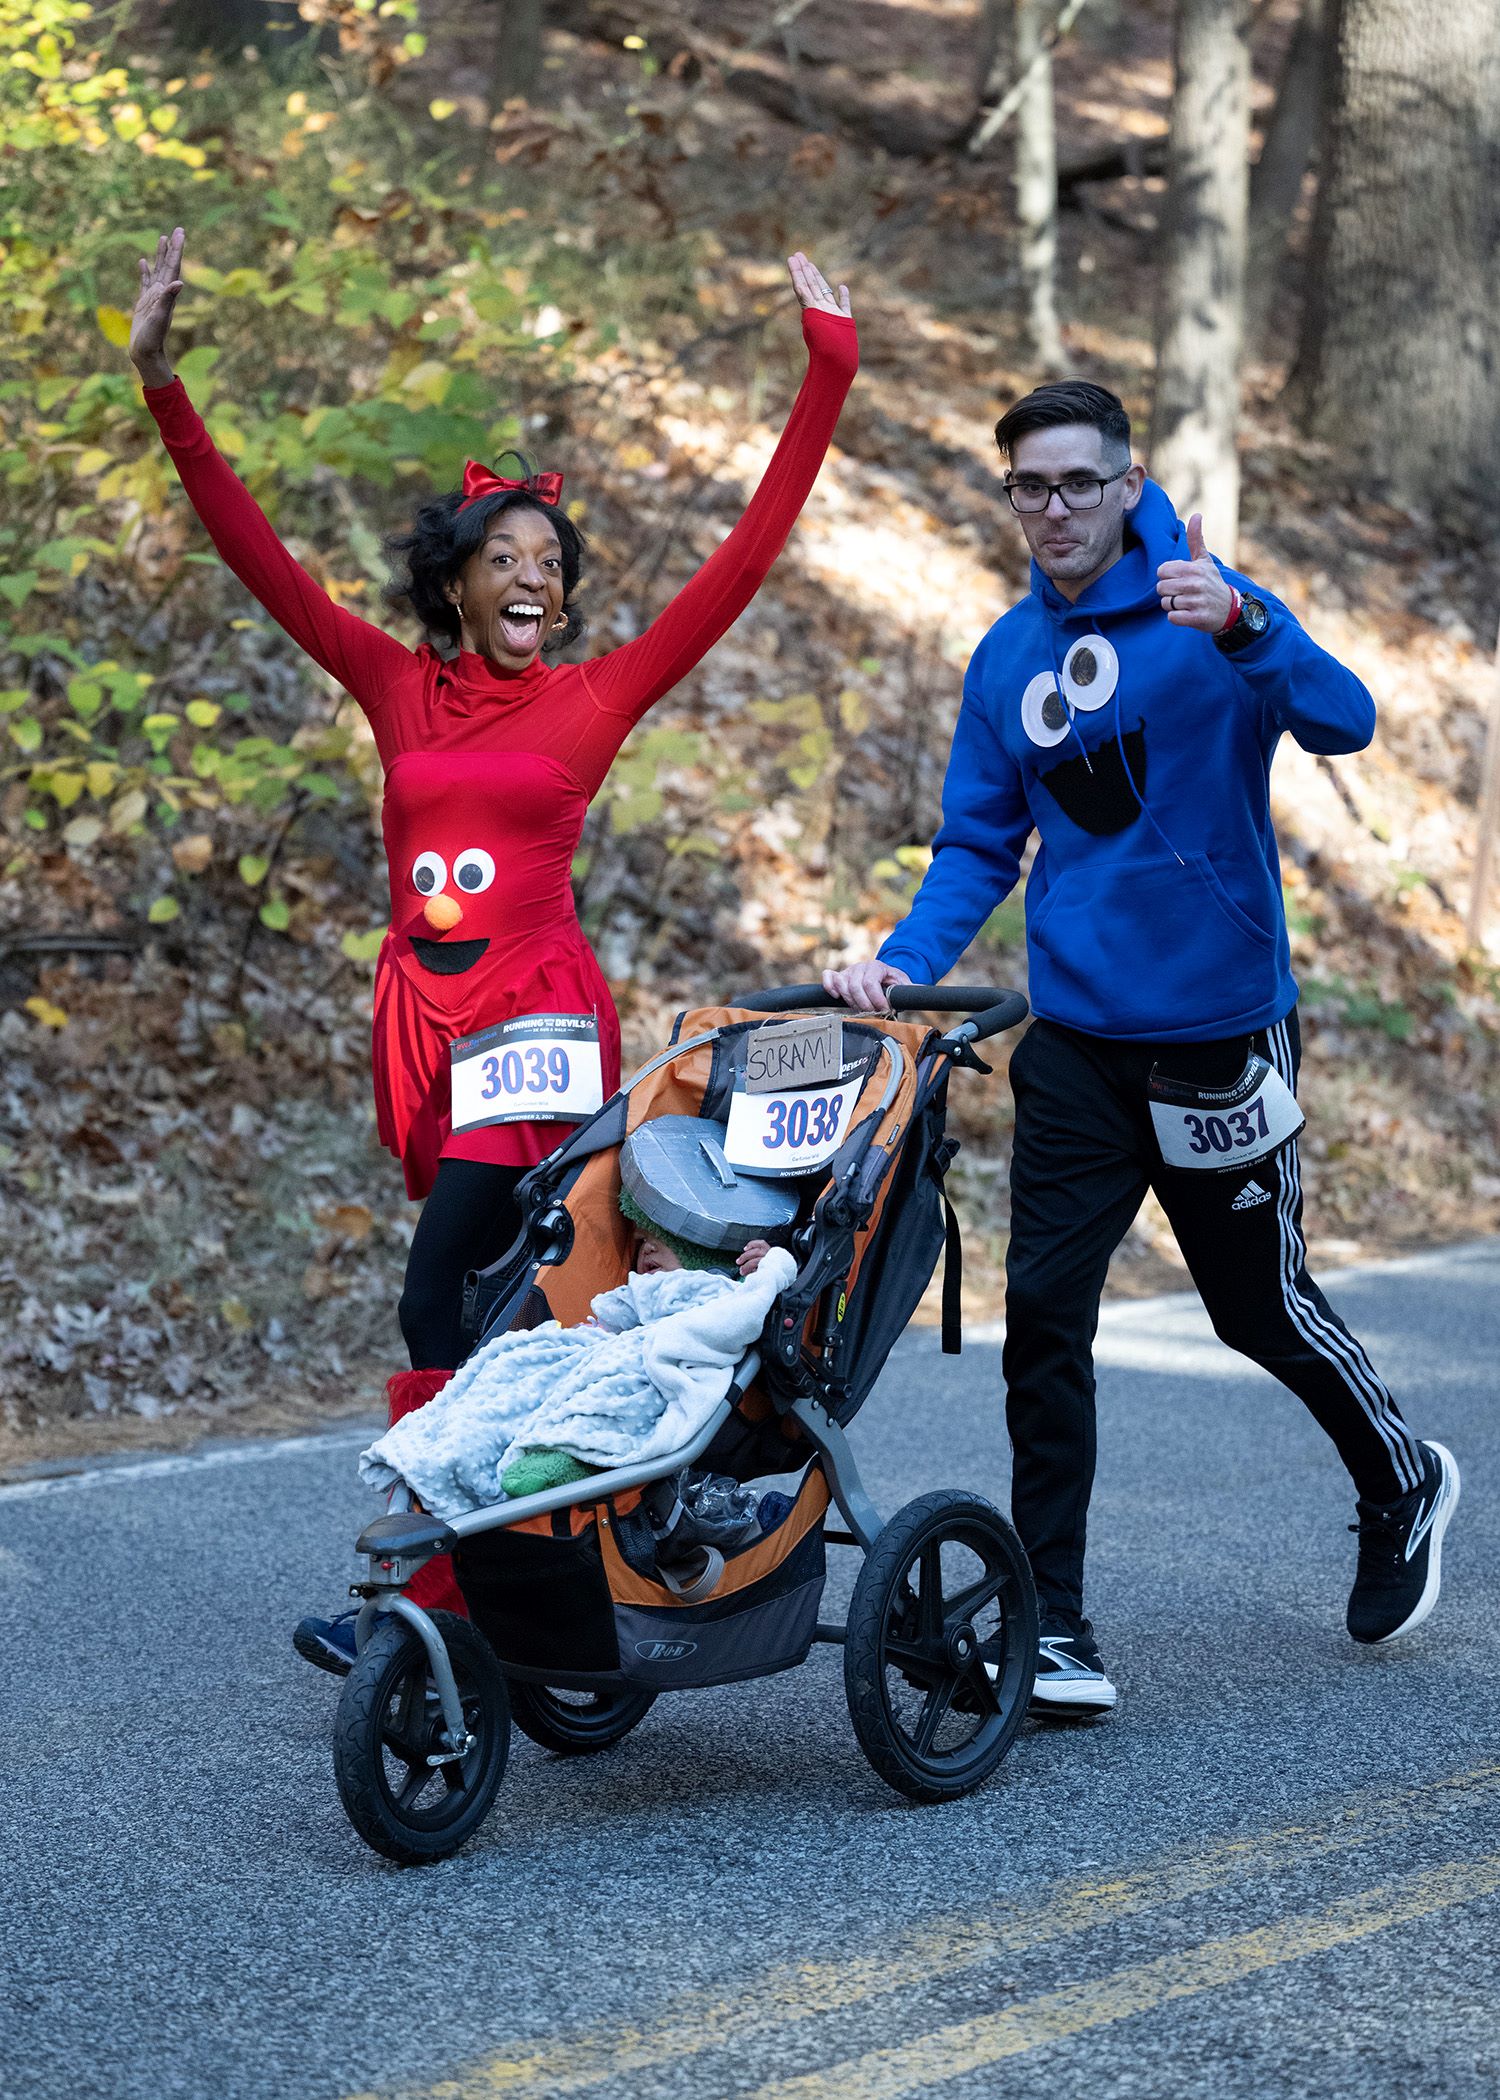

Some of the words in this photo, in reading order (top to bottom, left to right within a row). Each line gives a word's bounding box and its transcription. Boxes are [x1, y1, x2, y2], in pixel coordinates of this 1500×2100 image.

[503, 1019, 544, 1033] RUNNING
[555, 1019, 586, 1029] DEVILS
[481, 1047, 570, 1100] 3039
[749, 1033, 832, 1081] SCRAM!
[1198, 1089, 1237, 1101] RUNNING
[1244, 1059, 1260, 1086] DEVILS
[762, 1094, 843, 1149] 3038
[1184, 1095, 1270, 1154] 3037
[1217, 1164, 1248, 1174] NOVEMBER
[1231, 1191, 1272, 1211] adidas
